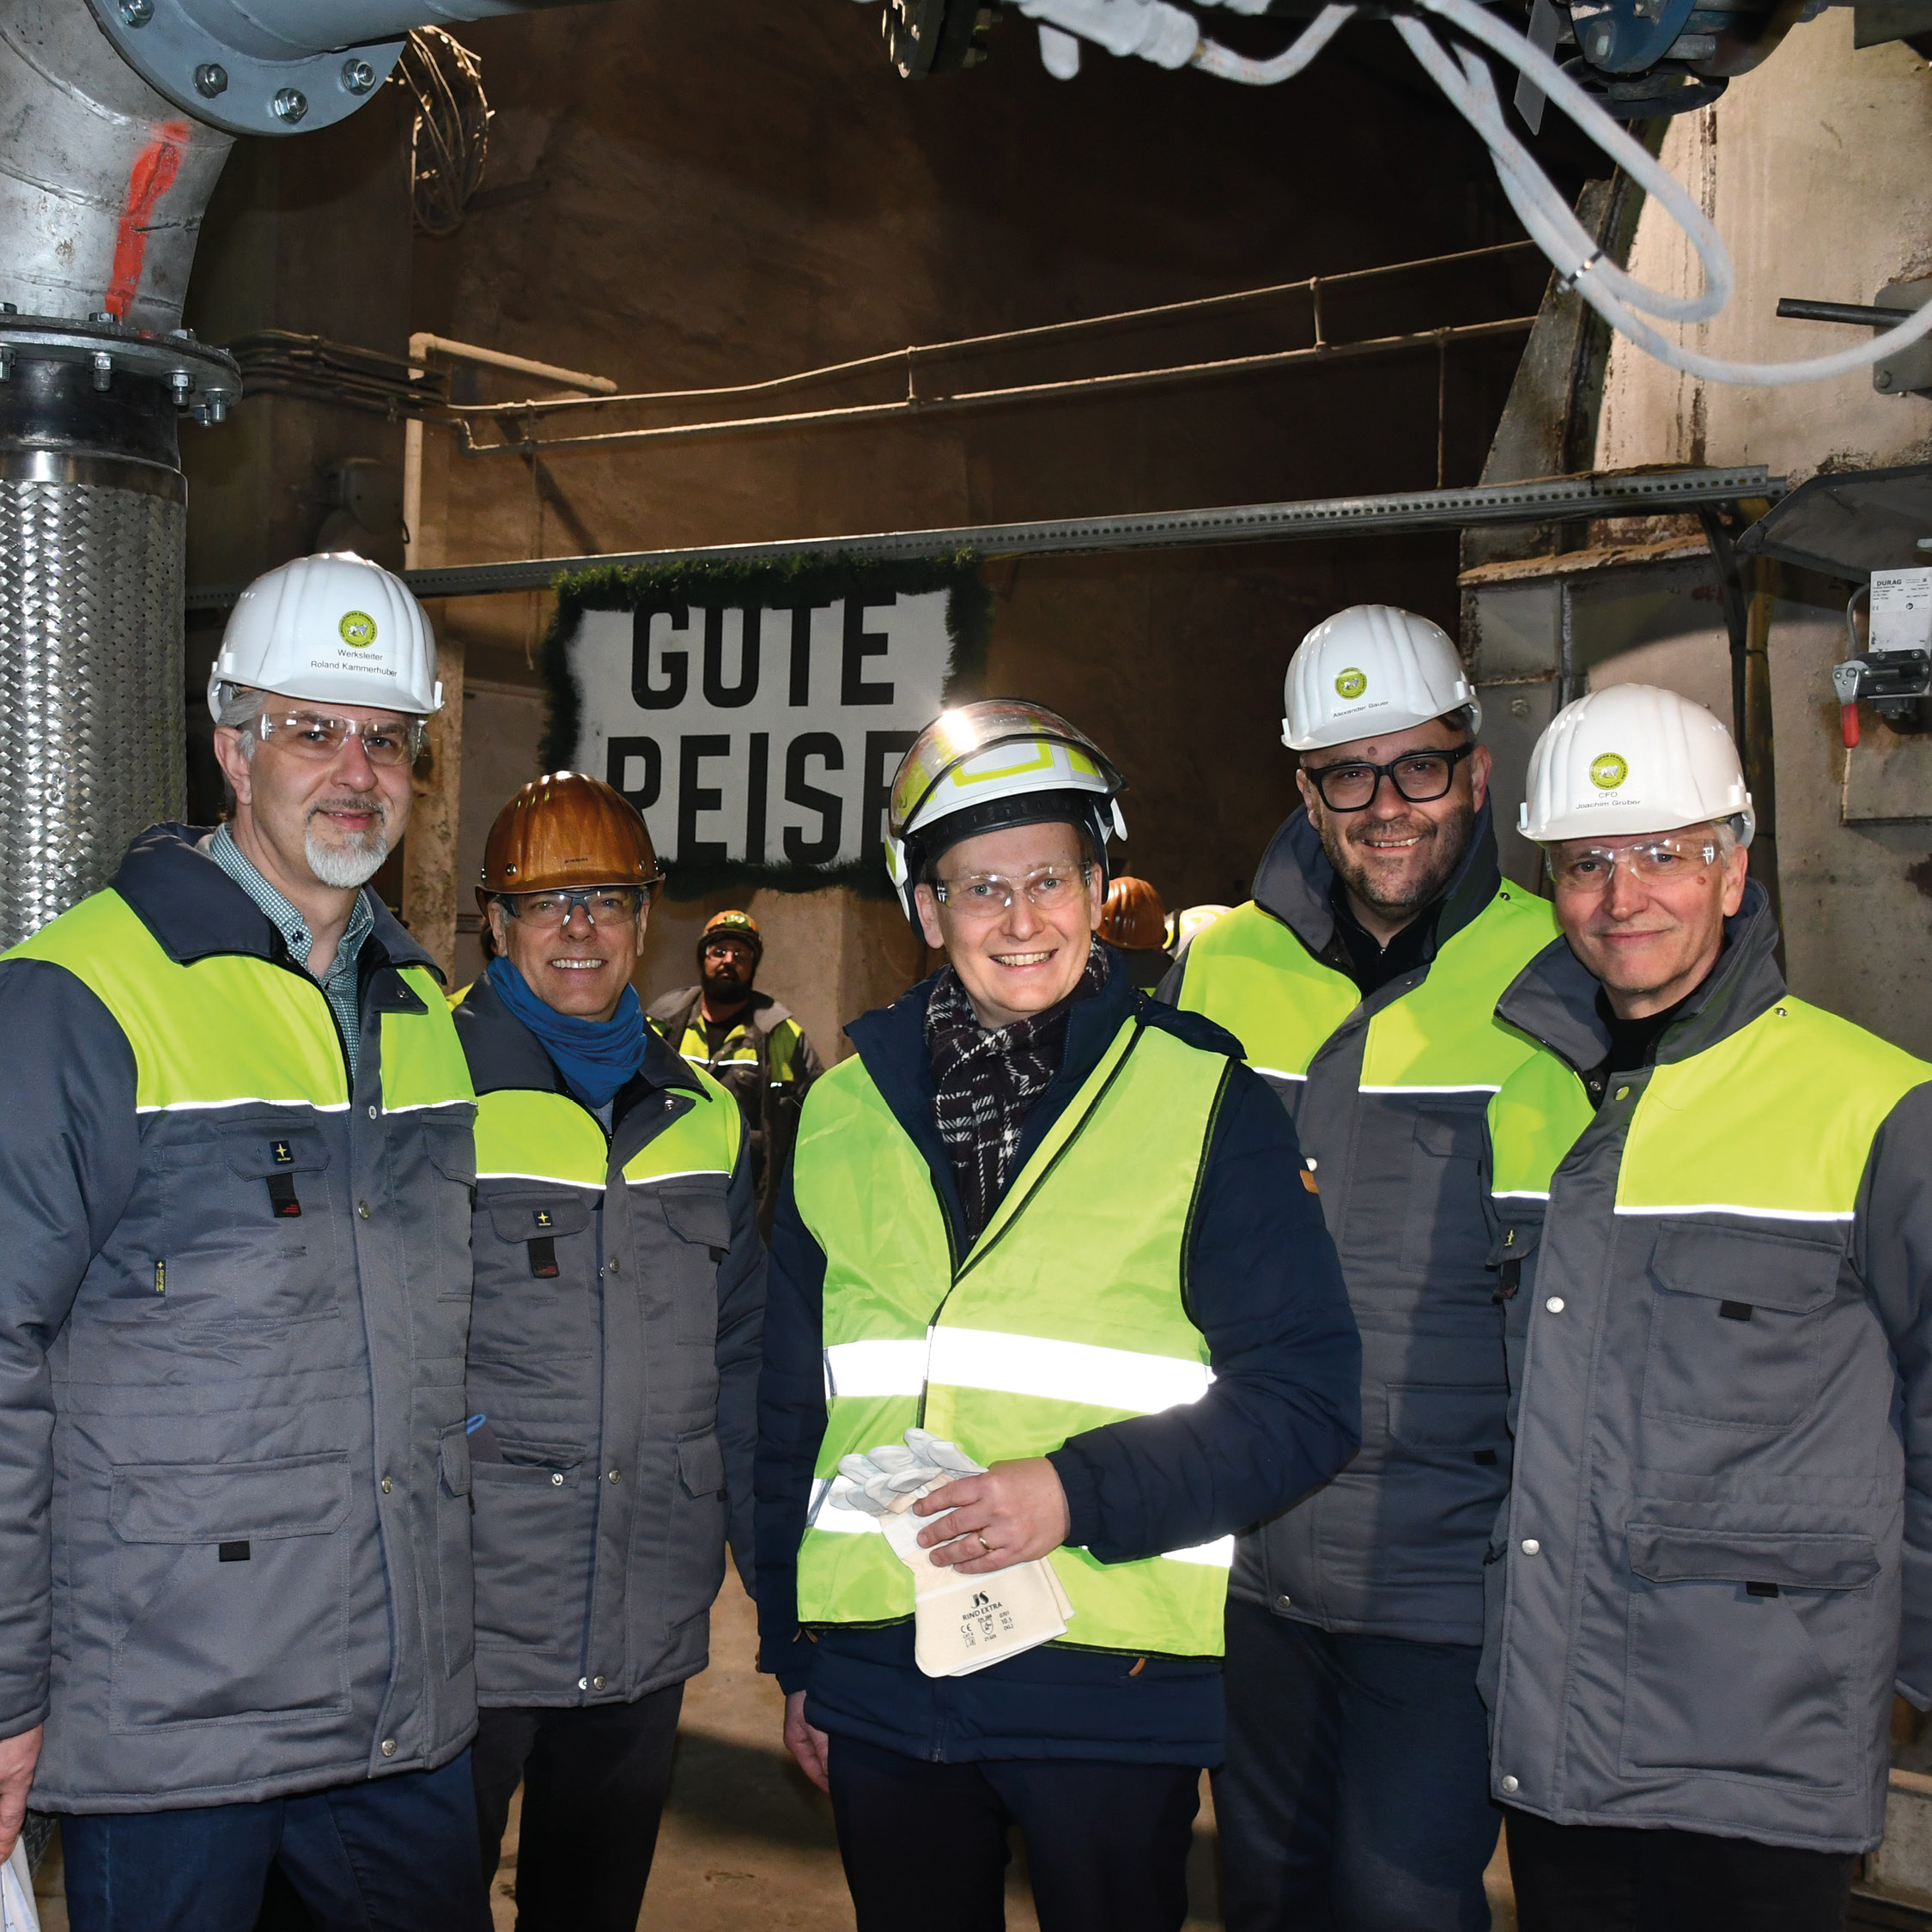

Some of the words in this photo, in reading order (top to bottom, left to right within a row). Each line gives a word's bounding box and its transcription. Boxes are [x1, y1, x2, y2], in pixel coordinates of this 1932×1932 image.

[337, 649, 383, 660] Werksleiter
[631, 591, 897, 710] GUTE
[311, 660, 340, 669] Roland
[342, 662, 398, 677] Kammerhuber
[1333, 705, 1367, 718] Alexander
[1368, 701, 1388, 709] Bauer
[606, 730, 919, 864] REISE
[970, 1590, 990, 1609] JS
[962, 1609, 981, 1621] RIND
[981, 1601, 1003, 1614] EXTRA
